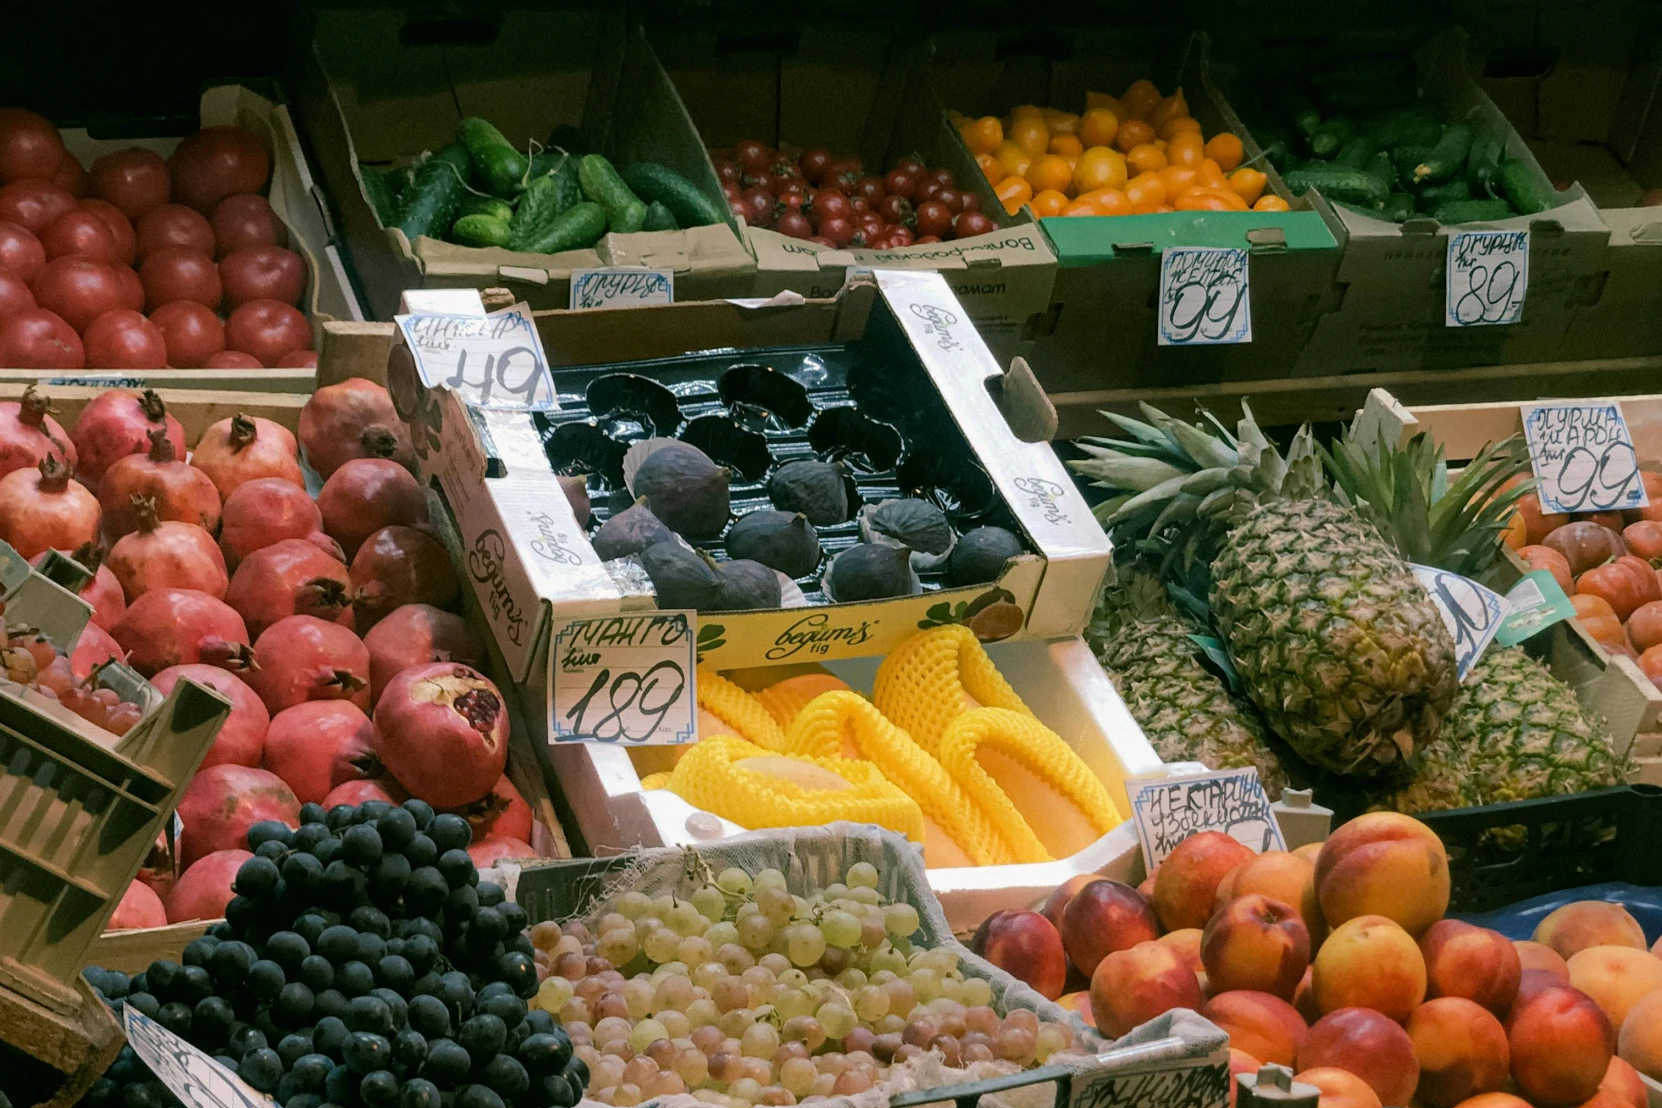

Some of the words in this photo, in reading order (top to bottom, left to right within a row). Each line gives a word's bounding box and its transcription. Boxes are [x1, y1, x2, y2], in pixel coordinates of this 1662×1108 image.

[875, 237, 1036, 261] Волрадский
[1169, 273, 1248, 343] 99
[1456, 260, 1520, 325] 89
[446, 346, 543, 406] 49
[1558, 441, 1639, 511] 99
[569, 613, 687, 647] МАНГО
[810, 643, 829, 655] fig
[565, 660, 685, 742] 189
